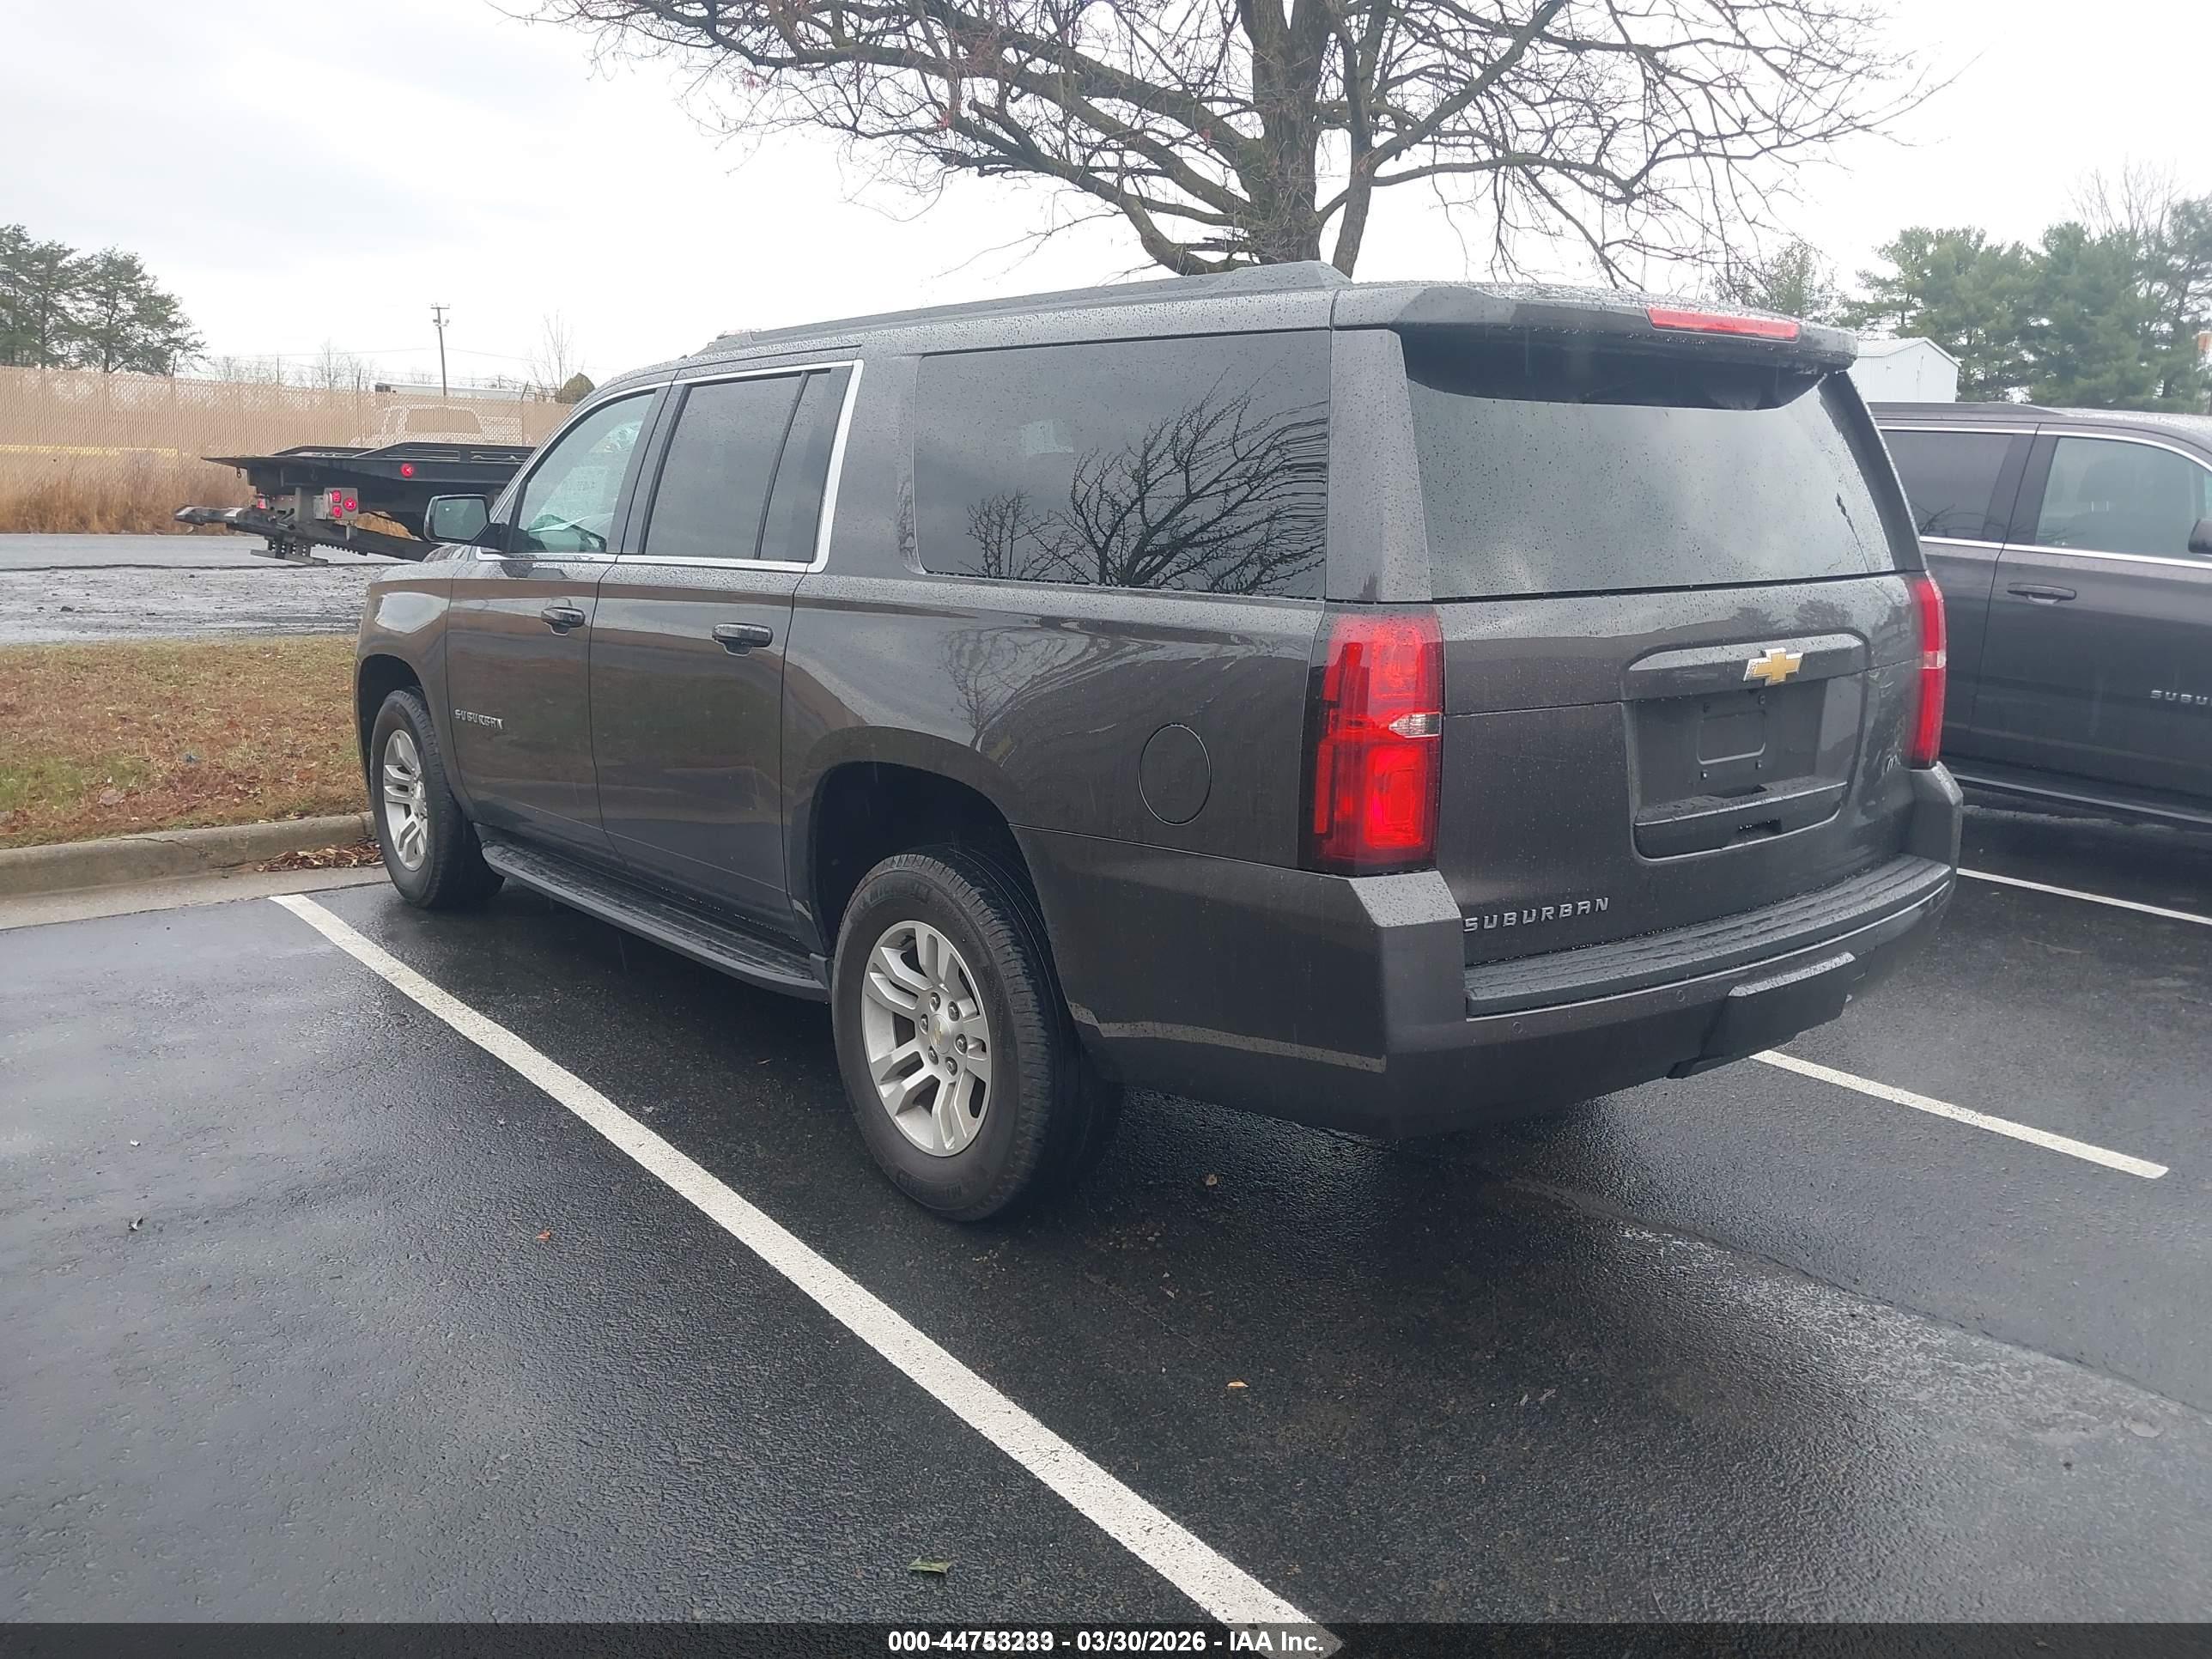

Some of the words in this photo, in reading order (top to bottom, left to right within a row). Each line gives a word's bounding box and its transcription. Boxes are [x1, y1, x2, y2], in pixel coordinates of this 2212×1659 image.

[2150, 690, 2212, 706] SUBU
[454, 708, 503, 730] SUBURBAN
[1463, 897, 1609, 932] SUBURBAN
